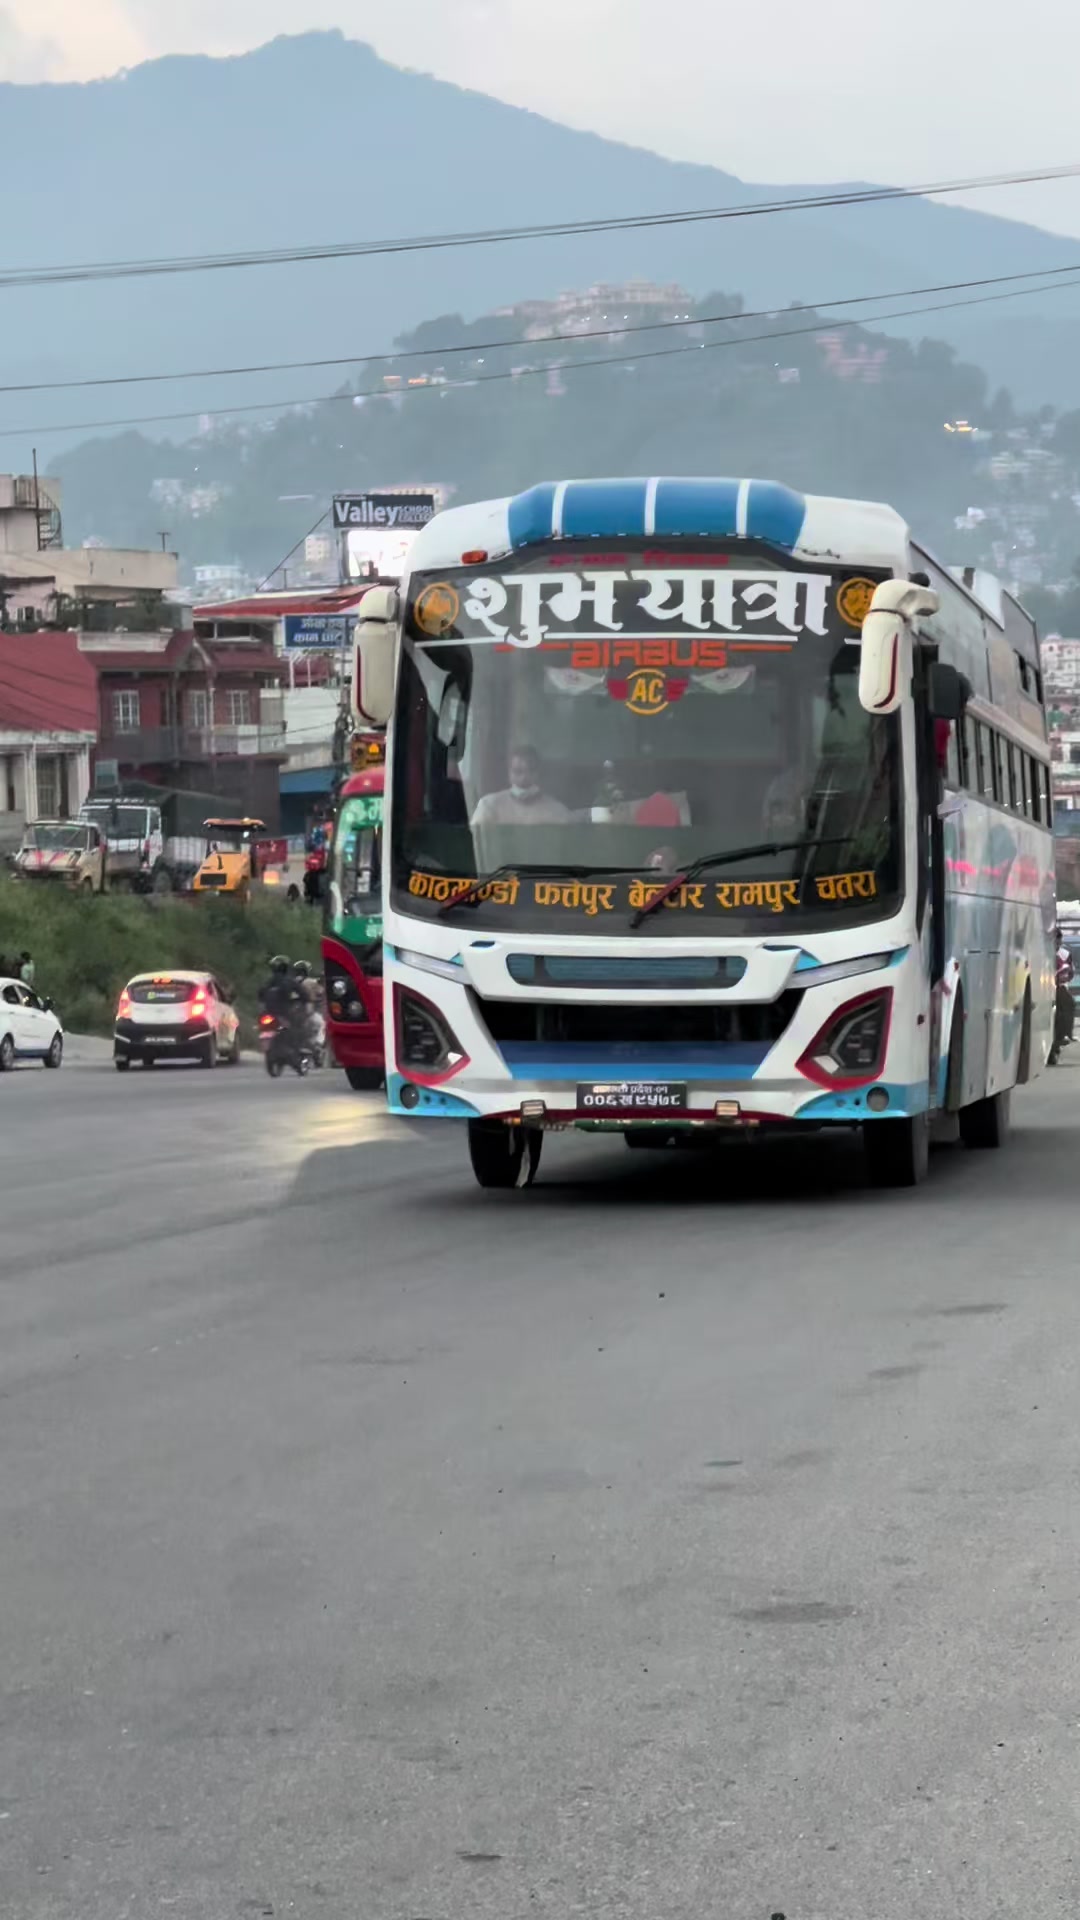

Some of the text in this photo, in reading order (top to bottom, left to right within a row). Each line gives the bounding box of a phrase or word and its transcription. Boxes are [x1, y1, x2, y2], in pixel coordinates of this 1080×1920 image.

[335, 501, 399, 526] Valley
[631, 678, 664, 703] AC
[534, 879, 617, 915] फत्तेपुर
[715, 879, 800, 912] रामपुर
[815, 870, 877, 900] चतरा
